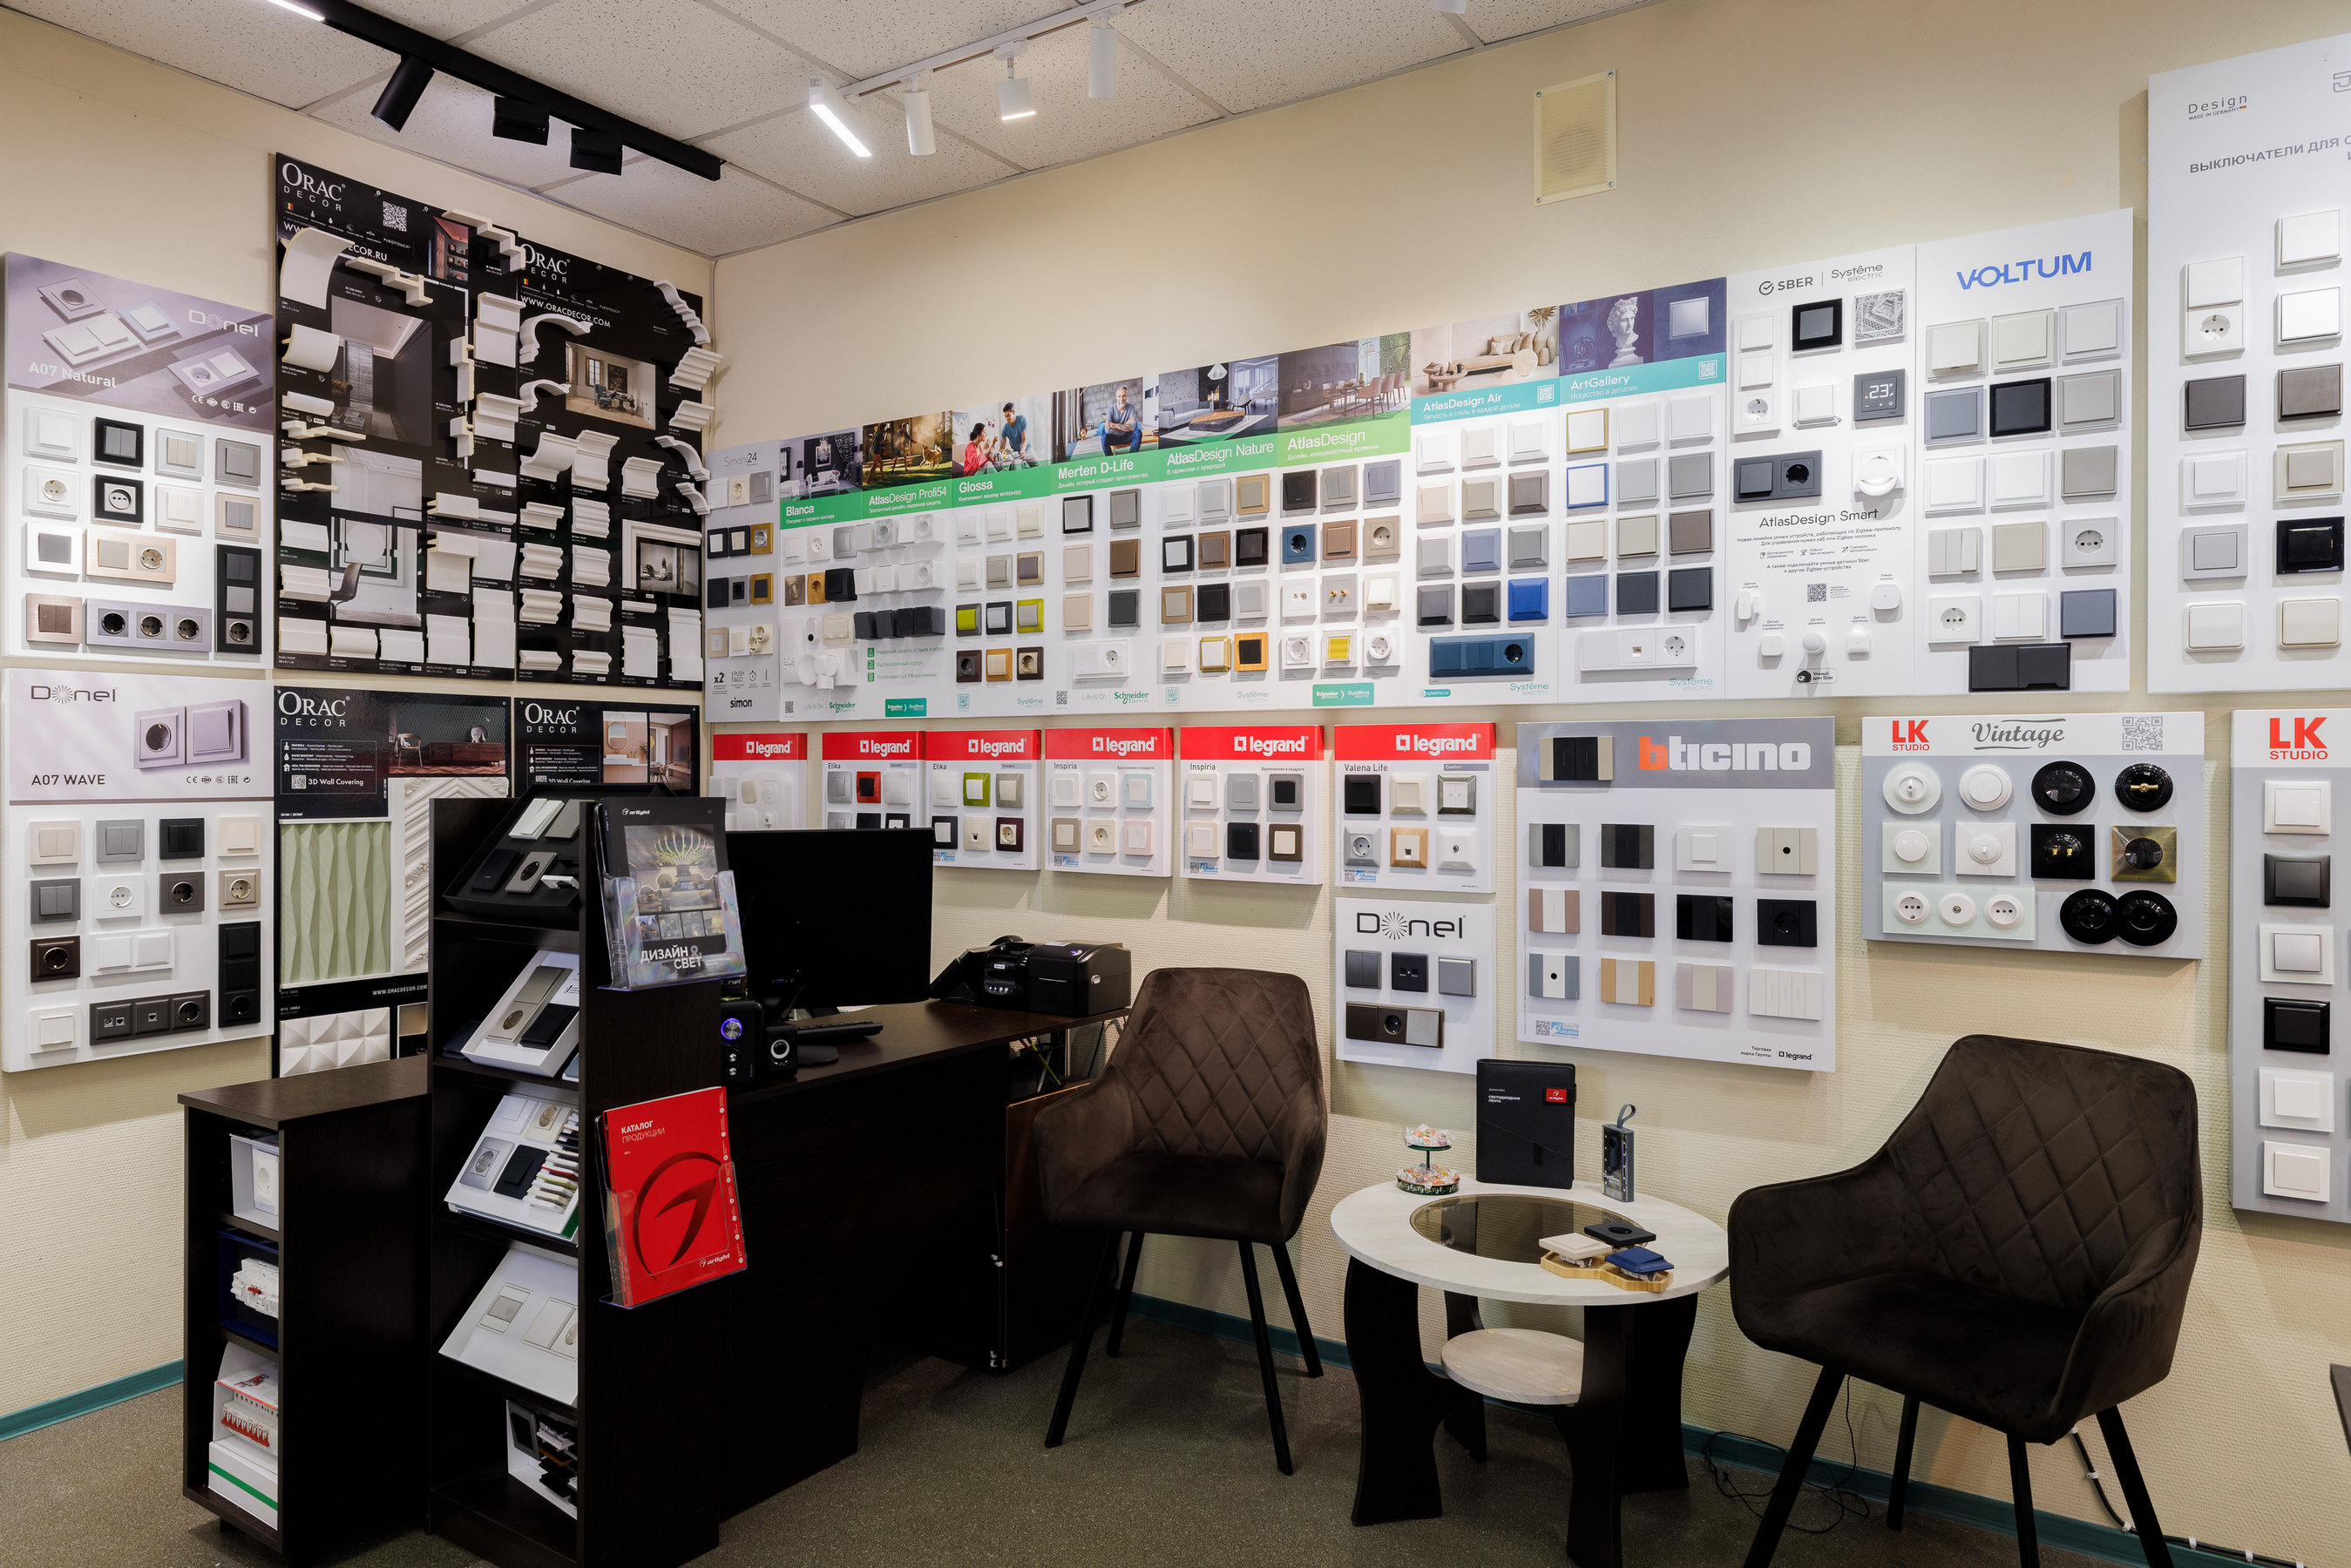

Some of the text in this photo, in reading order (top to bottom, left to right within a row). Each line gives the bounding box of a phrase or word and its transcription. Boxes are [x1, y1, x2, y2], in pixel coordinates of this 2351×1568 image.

[2188, 94, 2247, 114] Design
[2212, 107, 2239, 116] GERMANY
[2190, 144, 2304, 173] ВЫКЛЮЧАТЕЛИ
[2308, 138, 2339, 154] ДЛЯ
[282, 162, 342, 201] ORAC
[284, 186, 342, 212] DECOR
[1778, 264, 1883, 291] SBER Système
[1847, 270, 1883, 283] electric
[1956, 251, 2092, 290] VOLTUM
[520, 295, 610, 328] WWW.ORACDECOR.COM
[29, 362, 117, 389] A07 Natural
[1570, 374, 1630, 391] ArtGallery
[1610, 385, 1638, 394] деталях
[1423, 393, 1502, 412] AtlasDesign Air
[1287, 430, 1365, 451] AtlasDesign
[747, 452, 757, 463] 24
[1167, 441, 1274, 467] AtlasDesign Nature
[1058, 459, 1134, 480] Merten D-Life
[959, 480, 993, 493] Glossa
[869, 486, 947, 506] AtlasDesign Profi54
[786, 505, 814, 517] Blanca
[1759, 508, 1879, 528] AtlasDesign Smart
[714, 672, 725, 683] x2
[1669, 677, 1714, 688] Système
[1114, 691, 1149, 700] Schneider
[1510, 683, 1549, 693] Système
[278, 692, 346, 716] ORAC
[730, 697, 752, 708] simon
[829, 701, 856, 710] Schneider
[281, 718, 346, 727] DECOR
[525, 703, 577, 725] ORAC
[1892, 720, 2065, 750] LK Vintage
[2270, 717, 2328, 749] LK
[755, 741, 791, 757] legrand
[871, 739, 910, 757] legrand
[980, 738, 1024, 757] legrand
[1106, 737, 1155, 756] legrand
[1250, 736, 1305, 756] legrand
[1413, 733, 1477, 756] legrand
[1639, 735, 1811, 771] bticino
[2270, 750, 2328, 760] STUDIO
[1054, 762, 1077, 771] Inspiria
[1190, 763, 1216, 772] Inspiria
[31, 774, 59, 785] A07
[63, 774, 105, 785] WAVE
[335, 778, 364, 787] Covering
[640, 945, 688, 964] ДИЗАЙН
[674, 956, 703, 970] СВЕТ
[372, 984, 427, 996] WWW.ORACDECOR.COM
[1786, 1051, 1812, 1061] legrand
[621, 1120, 654, 1134] КАТАЛОГ
[622, 1127, 666, 1143] ПРОДУКЦИИ
[707, 1253, 731, 1265] arlight
